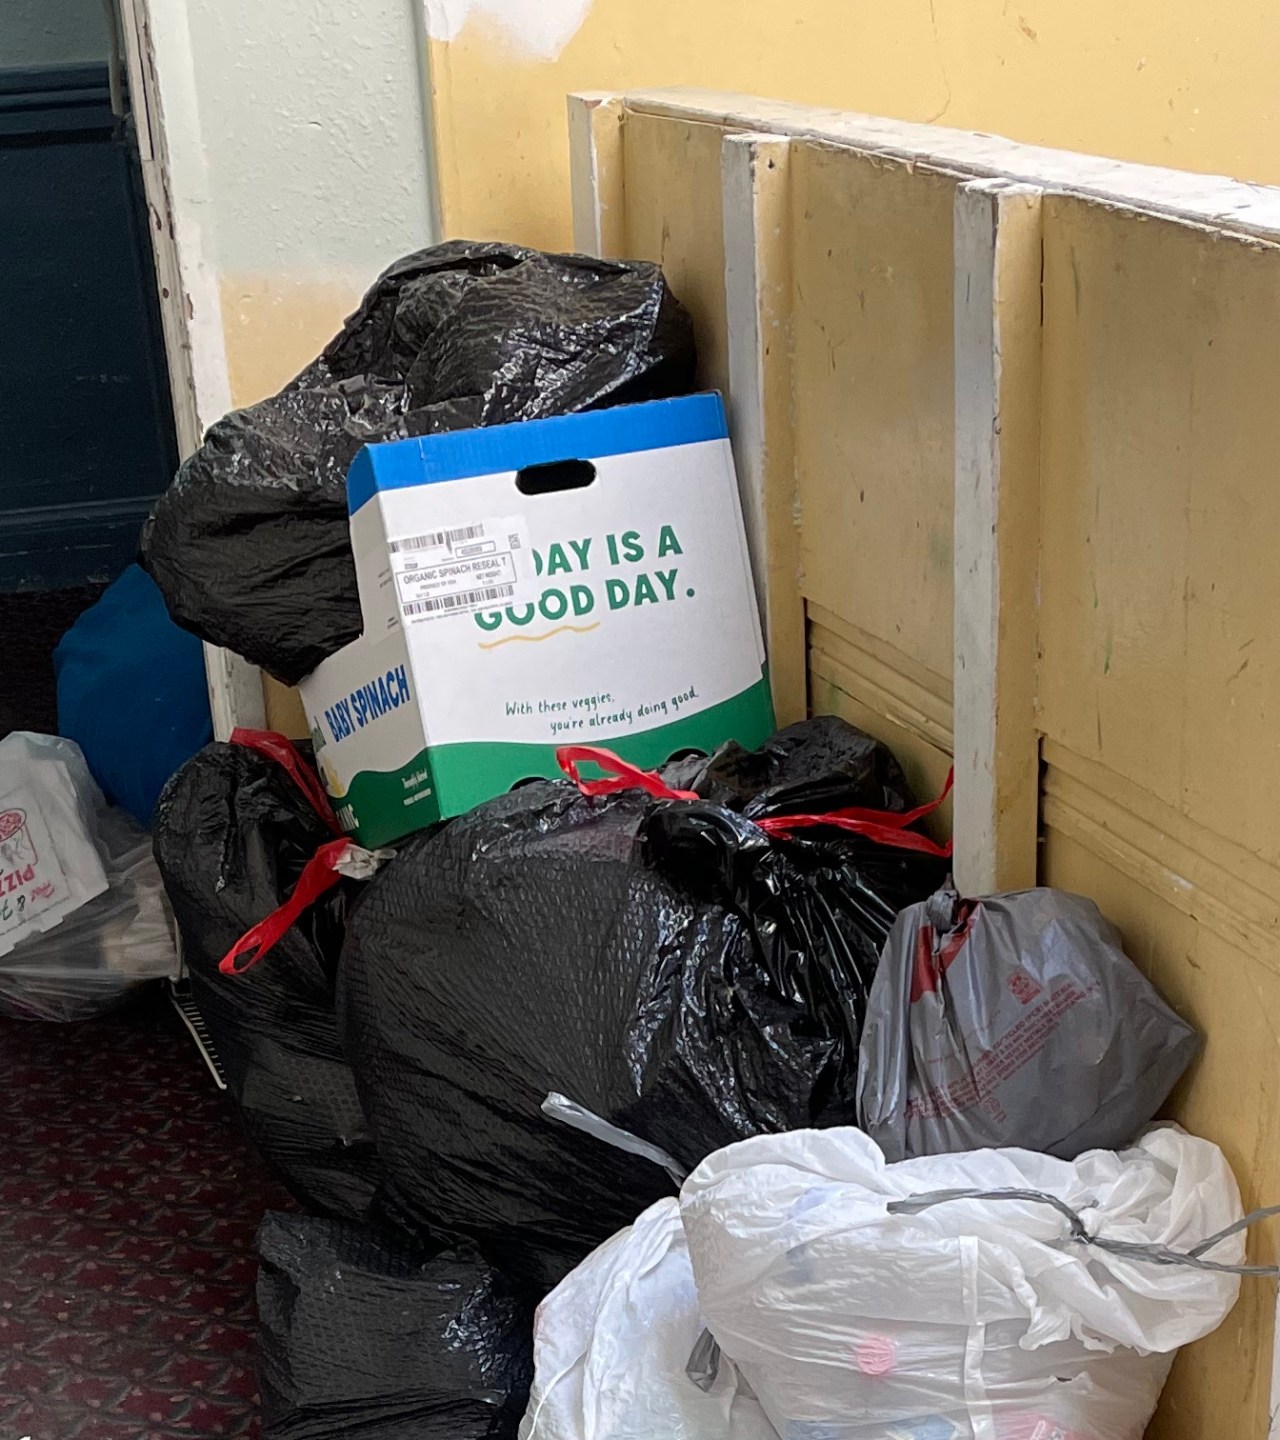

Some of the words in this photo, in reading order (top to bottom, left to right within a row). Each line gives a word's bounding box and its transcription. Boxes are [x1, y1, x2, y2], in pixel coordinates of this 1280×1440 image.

[606, 530, 645, 566] IS
[658, 525, 683, 557] A
[403, 570, 438, 585] ORGANIC
[439, 563, 471, 578] SPINACH
[472, 558, 499, 571] RESEAL
[605, 568, 695, 610] DAY.
[324, 698, 356, 743] BABY
[349, 663, 411, 729] SPINACH
[505, 701, 533, 716] With
[538, 700, 567, 714] these
[550, 717, 584, 736] you're
[589, 708, 634, 726] already
[637, 700, 668, 715] doing
[17, 894, 26, 912] &
[31, 880, 55, 903] Hot
